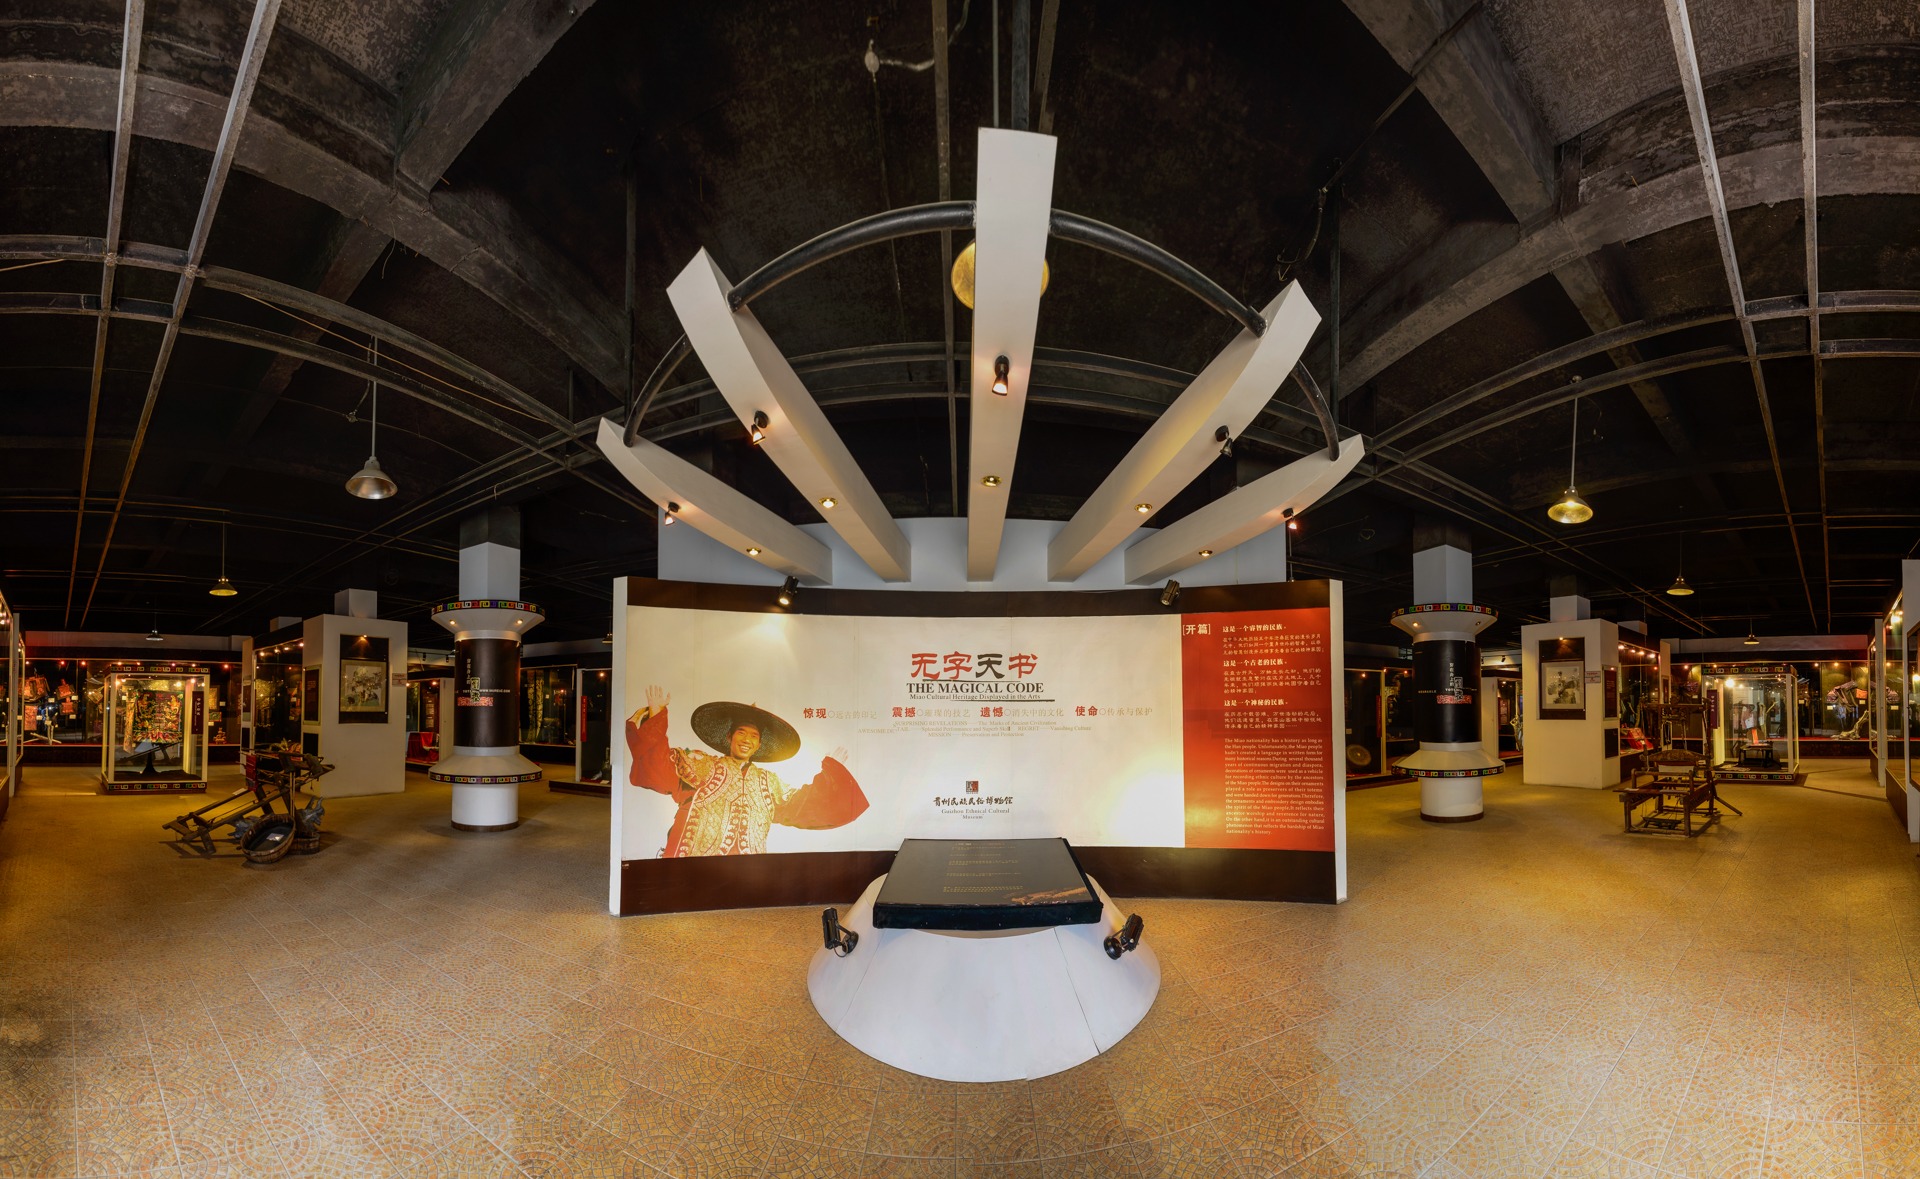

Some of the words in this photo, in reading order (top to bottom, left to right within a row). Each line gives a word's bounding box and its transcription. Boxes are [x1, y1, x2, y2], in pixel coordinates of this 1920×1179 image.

[911, 651, 1038, 679] 无字天书
[906, 683, 935, 693] THE
[938, 683, 1003, 693] MAGICAL
[1007, 683, 1044, 693] CODE
[803, 707, 827, 719] 惊现
[892, 706, 915, 718] 震撼
[980, 706, 1003, 717] 遗憾
[1012, 708, 1064, 717] 消失中的文化
[1075, 705, 1098, 716] 使命
[1107, 708, 1152, 716] 传承与保护
